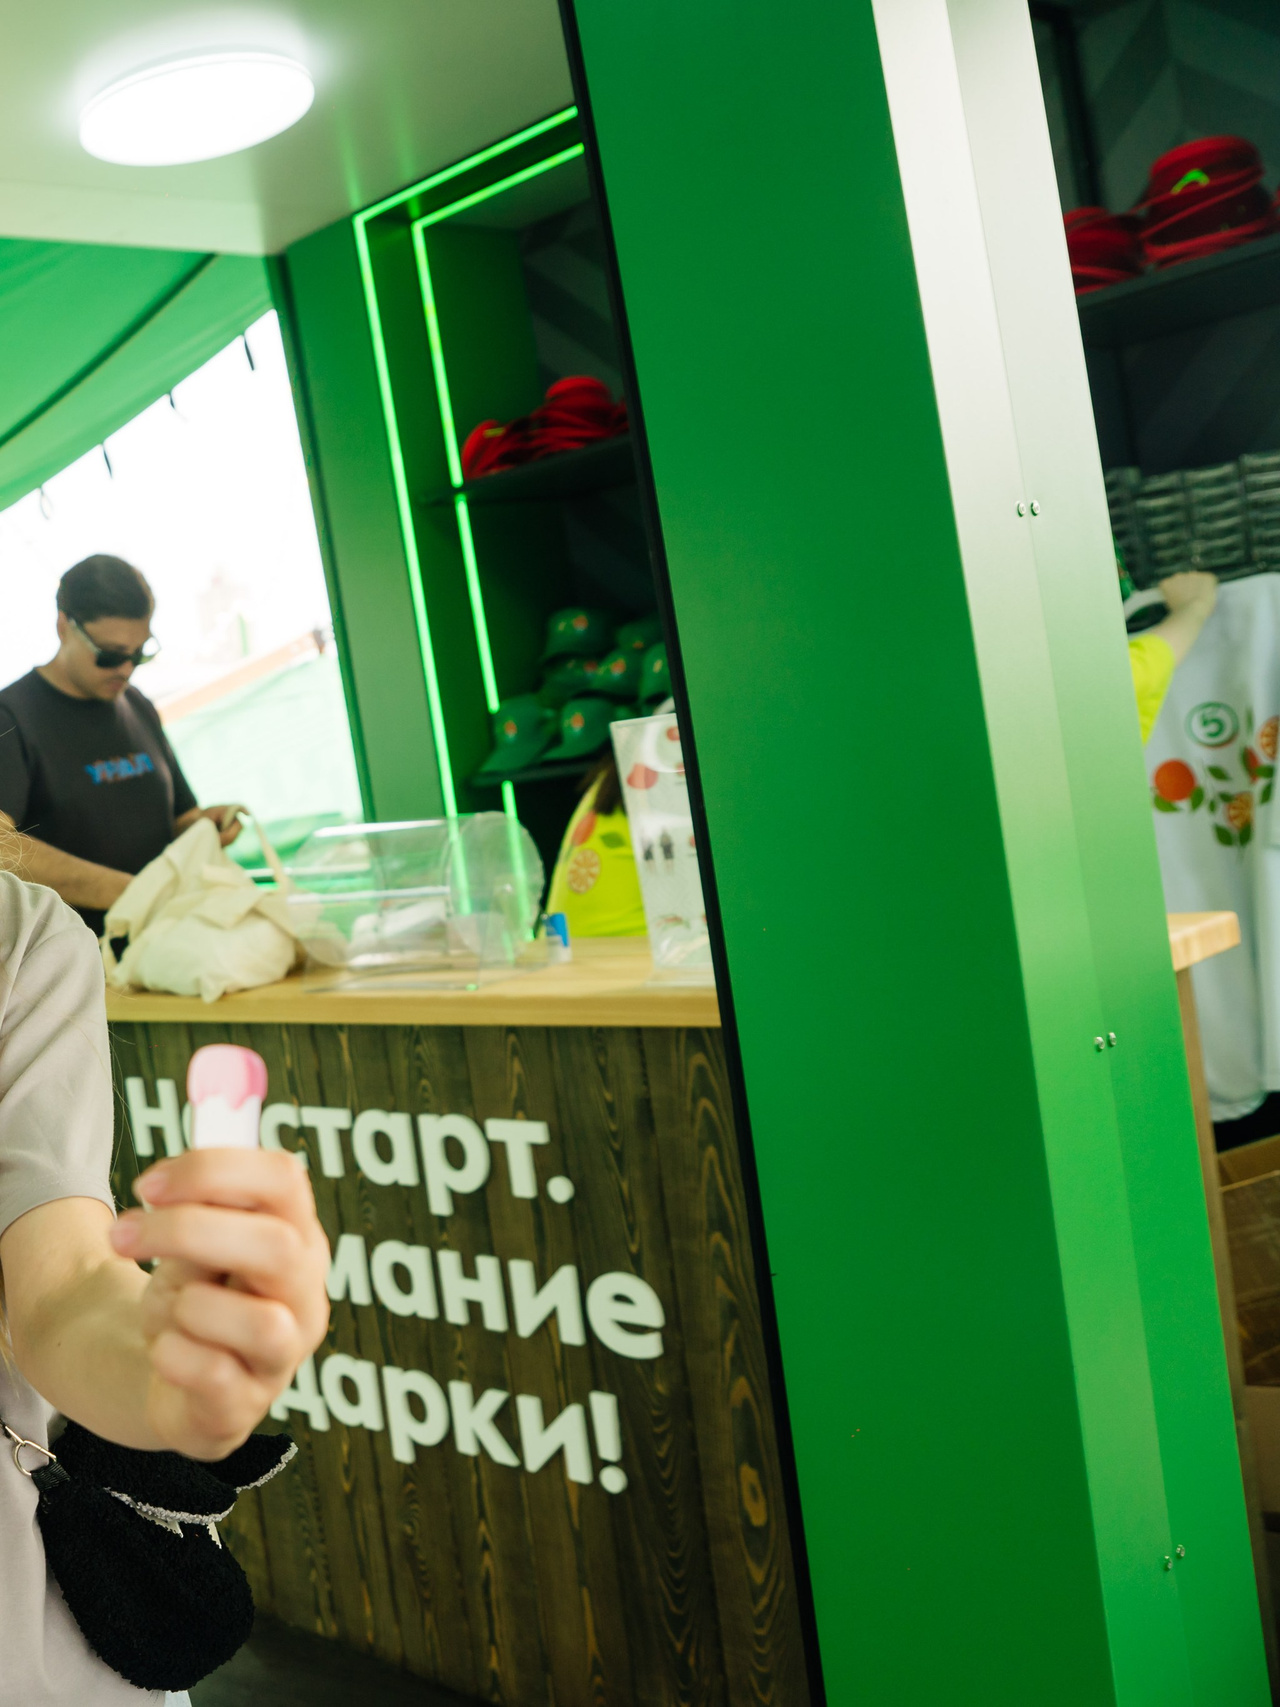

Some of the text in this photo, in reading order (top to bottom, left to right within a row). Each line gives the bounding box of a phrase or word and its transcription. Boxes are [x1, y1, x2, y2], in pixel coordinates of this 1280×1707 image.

[125, 1076, 575, 1217] Н старт.
[326, 1233, 666, 1360] мание
[269, 1352, 628, 1495] дарки!
